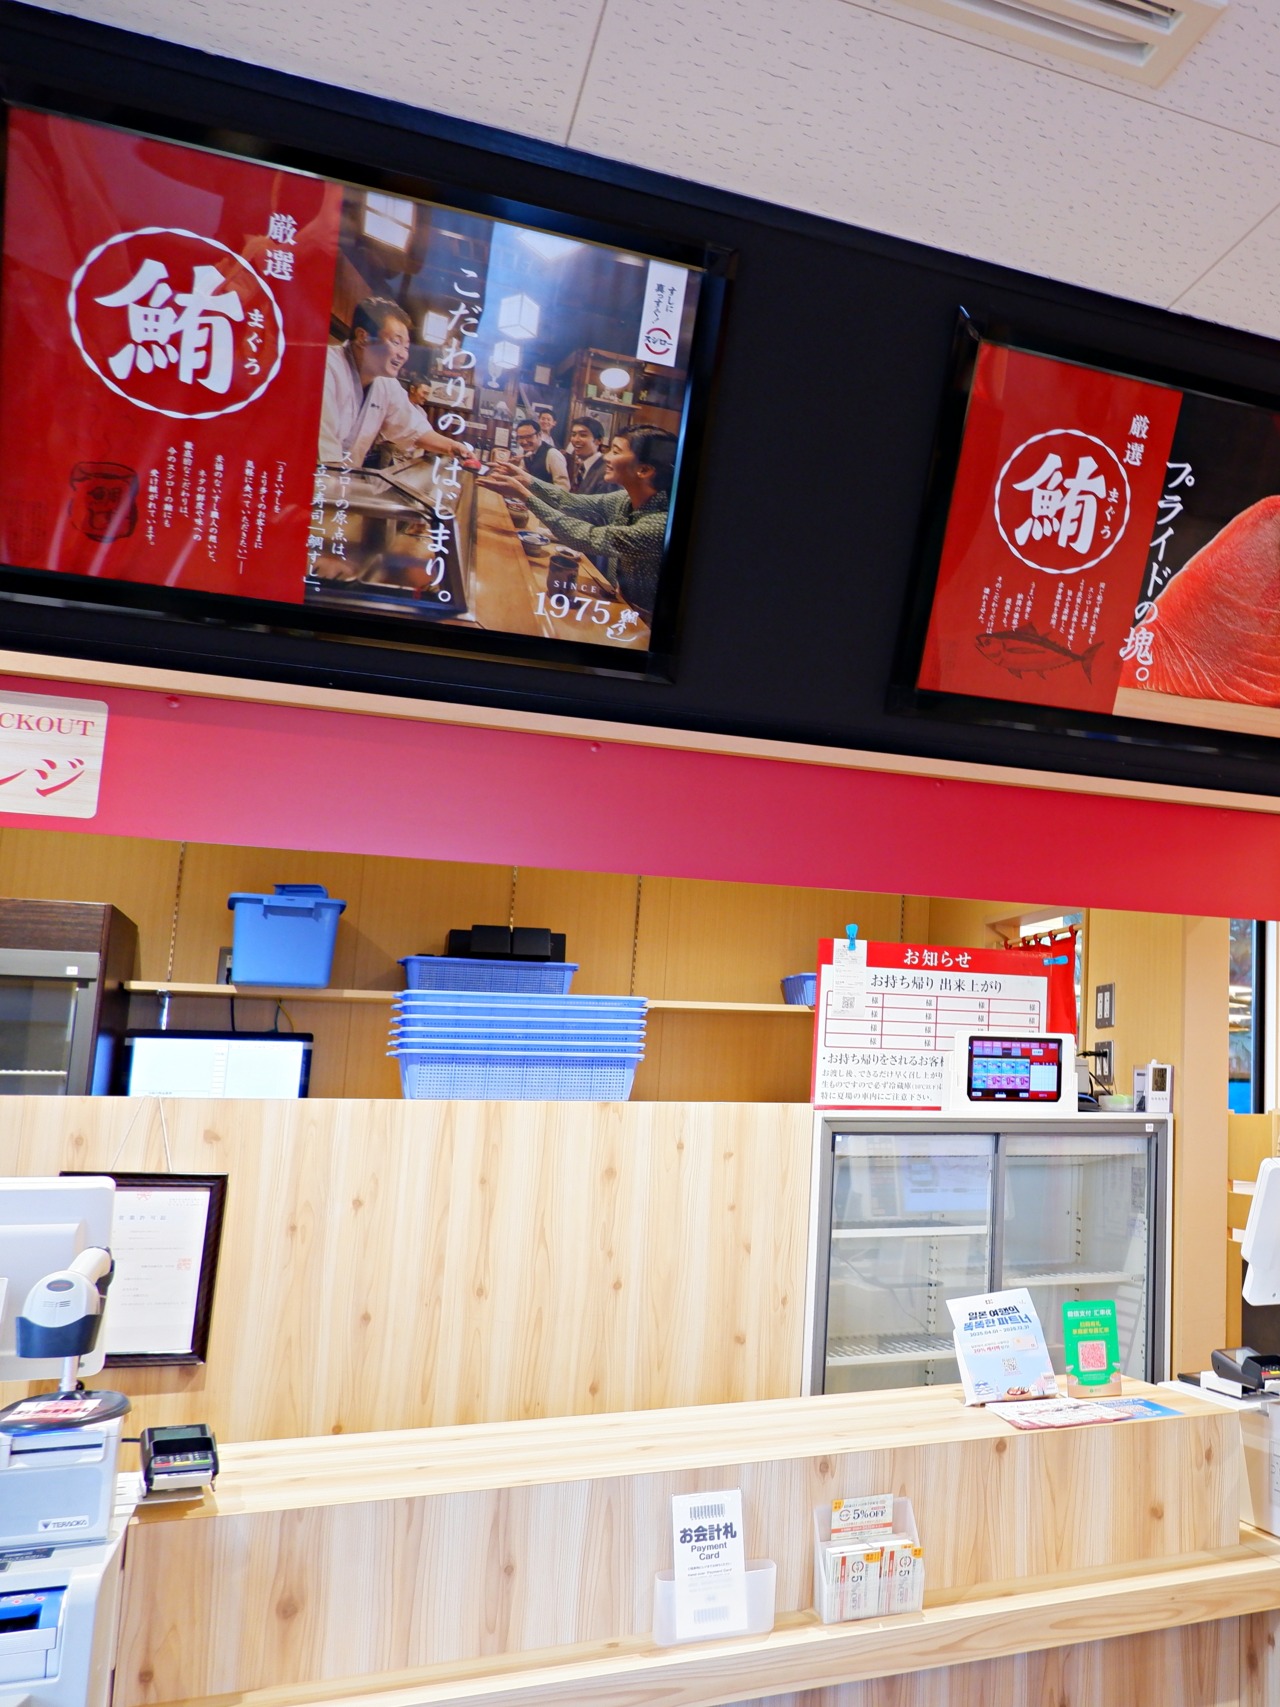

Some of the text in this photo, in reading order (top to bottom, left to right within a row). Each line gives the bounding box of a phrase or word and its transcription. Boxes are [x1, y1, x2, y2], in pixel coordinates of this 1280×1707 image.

[264, 213, 298, 282] 厳選
[94, 258, 244, 394] 鮪
[1123, 415, 1152, 467] 厳選
[1012, 452, 1106, 554] 鮪
[1119, 461, 1196, 683] プライドの塊。
[554, 580, 597, 593] SINCE
[534, 592, 611, 625] 1975
[903, 948, 972, 968] お知らせ
[871, 974, 1002, 993] お持ち帰り 出来上がり
[679, 1522, 737, 1544] お会計札
[691, 1541, 727, 1552] Payment
[699, 1551, 720, 1561] Card
